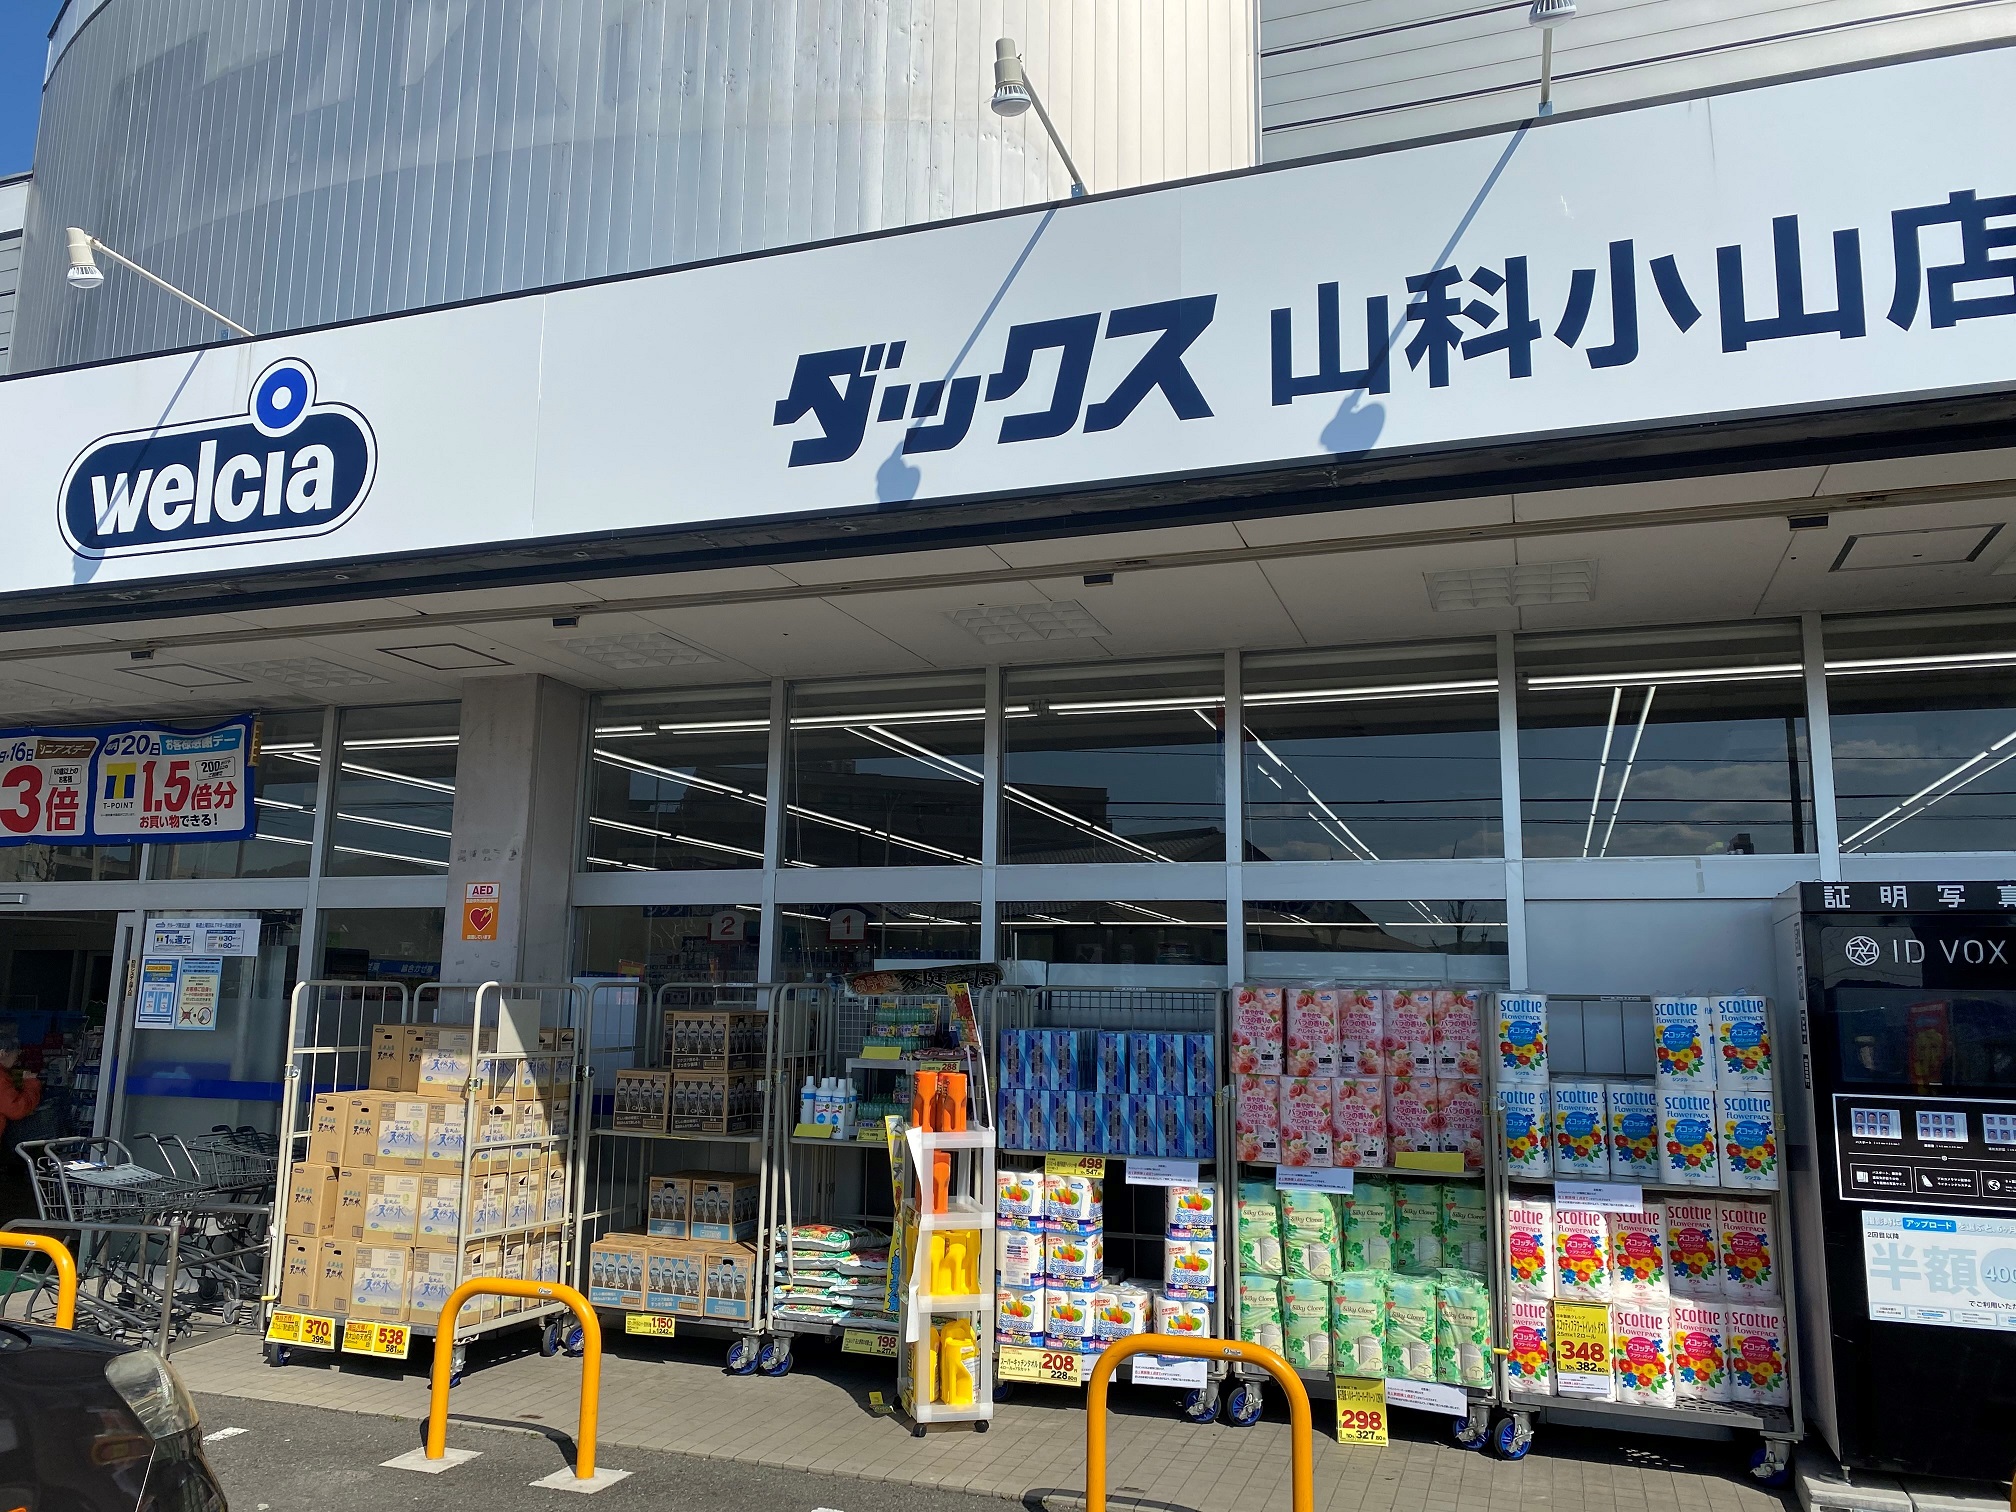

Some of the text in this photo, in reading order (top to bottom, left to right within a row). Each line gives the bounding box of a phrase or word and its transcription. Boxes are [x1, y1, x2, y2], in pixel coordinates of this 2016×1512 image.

[774, 190, 2016, 469] ダックス 山科小山店
[91, 440, 334, 536] welcia
[165, 734, 236, 750] お客様感謝デー
[40, 744, 91, 755] シニアズデー
[103, 801, 134, 810] T-POINT
[472, 885, 494, 895] AED
[1824, 884, 2016, 909] 証明写真
[720, 915, 736, 936] 2
[841, 914, 852, 935] 1
[1892, 939, 2009, 965] ID VOX
[1238, 1016, 1273, 1024] バラの香りの
[1294, 1019, 1330, 1027] バラの香りの
[1391, 1020, 1427, 1028] バラの香りの
[942, 1063, 957, 1071] 288
[1500, 1091, 1536, 1105] cottie
[1288, 1110, 1324, 1118] バラの香りの
[1566, 1117, 1592, 1125] スコッティ
[1623, 1119, 1650, 1127] スコッティ
[1676, 1125, 1703, 1133] スコッティ
[1736, 1127, 1764, 1135] スコッティ
[1078, 1157, 1103, 1169] 498
[1085, 1168, 1098, 1176] 547
[1509, 1210, 1544, 1226] cottie
[1905, 1219, 1953, 1231] アップロード
[1679, 1234, 1705, 1243] スコッティ
[1867, 1231, 1900, 1240] 2回目以降
[1510, 1238, 1535, 1247] スコッティ
[1566, 1240, 1593, 1249] スコッティ
[1625, 1238, 1652, 1248] スコッティ
[1732, 1237, 1760, 1247] スコッティ
[1870, 1242, 1981, 1297] 半額
[305, 1319, 330, 1336] 370
[311, 1335, 324, 1344] 399
[378, 1328, 404, 1345] 538
[877, 1335, 897, 1348] 198
[1513, 1332, 1539, 1341] スコッティ
[1685, 1337, 1713, 1348] スコッティ
[1742, 1342, 1771, 1352] スコッティ
[385, 1345, 397, 1353] 581
[1561, 1340, 1605, 1362] 348
[1627, 1342, 1656, 1354] スコッティ
[1342, 1409, 1383, 1431] 298
